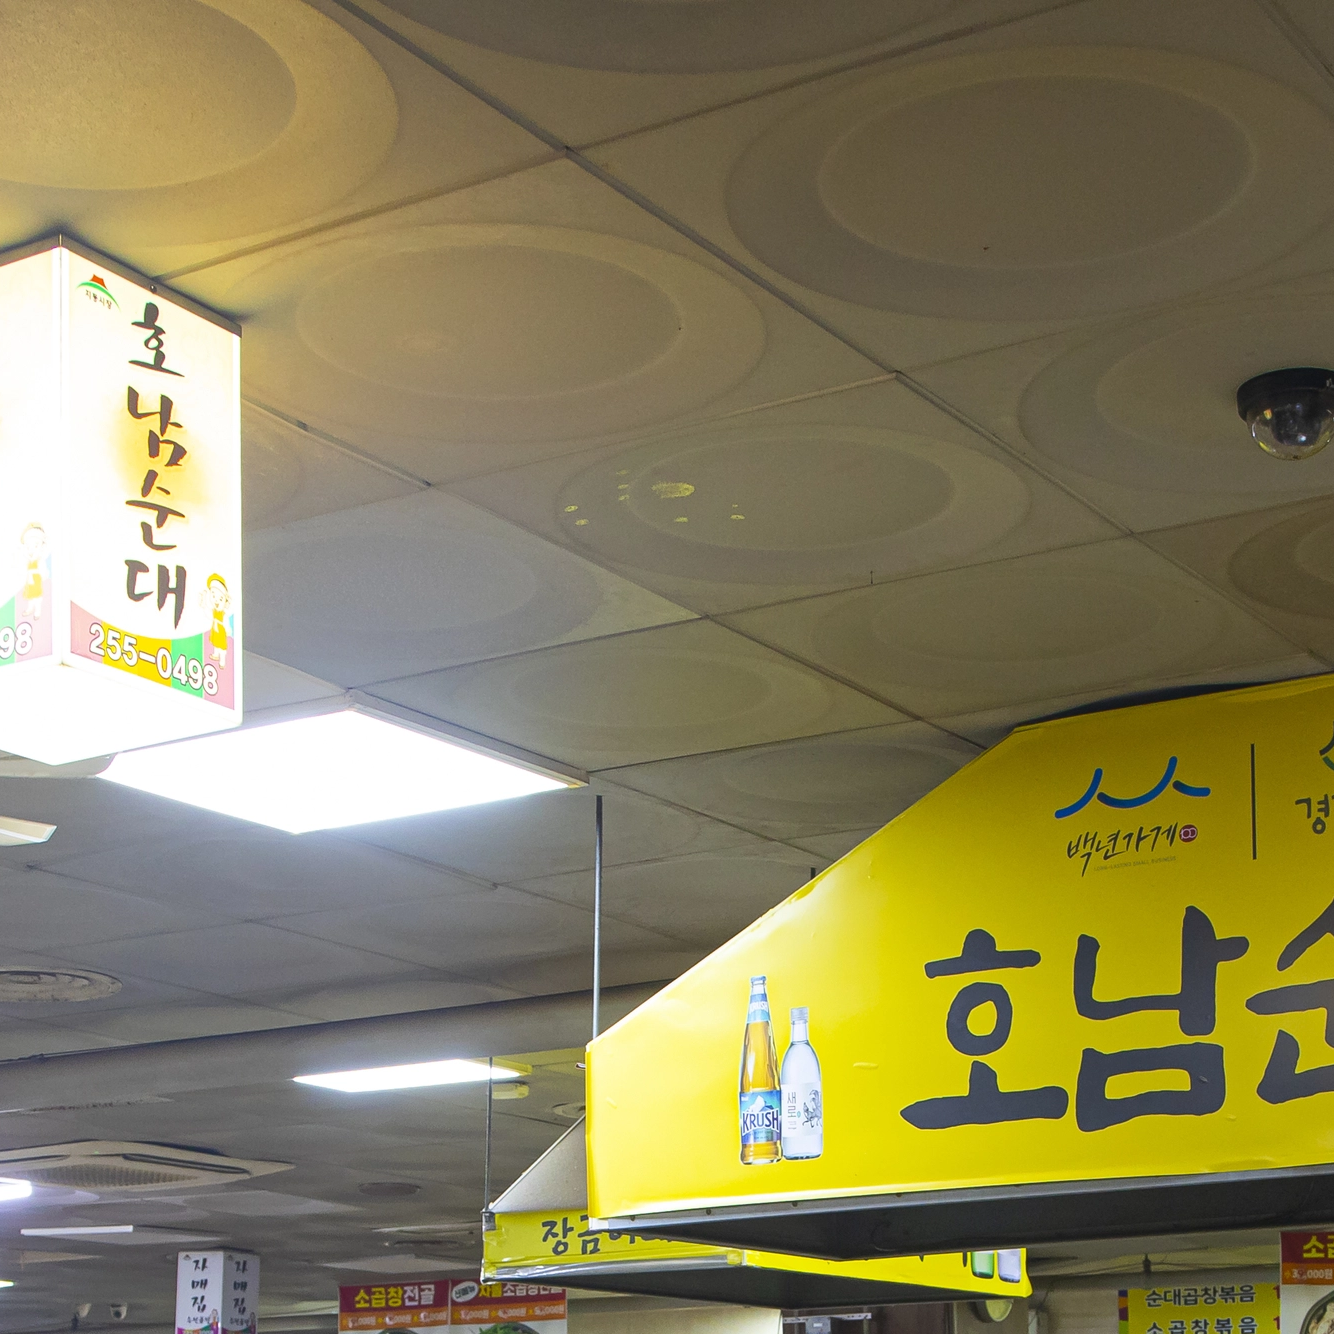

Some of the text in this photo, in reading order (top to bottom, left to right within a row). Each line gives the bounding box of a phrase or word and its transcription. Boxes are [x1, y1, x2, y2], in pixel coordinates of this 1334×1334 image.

[124, 302, 187, 629] 호남순대
[89, 621, 219, 697] 255-0498
[1067, 822, 1179, 878] 백년가게
[742, 1109, 780, 1135] KRUSH
[191, 1257, 208, 1313] 자매집
[233, 1260, 249, 1315] 자매집
[354, 1283, 436, 1309] 소곱창전골
[1145, 1284, 1257, 1308] 순대곱창볶음
